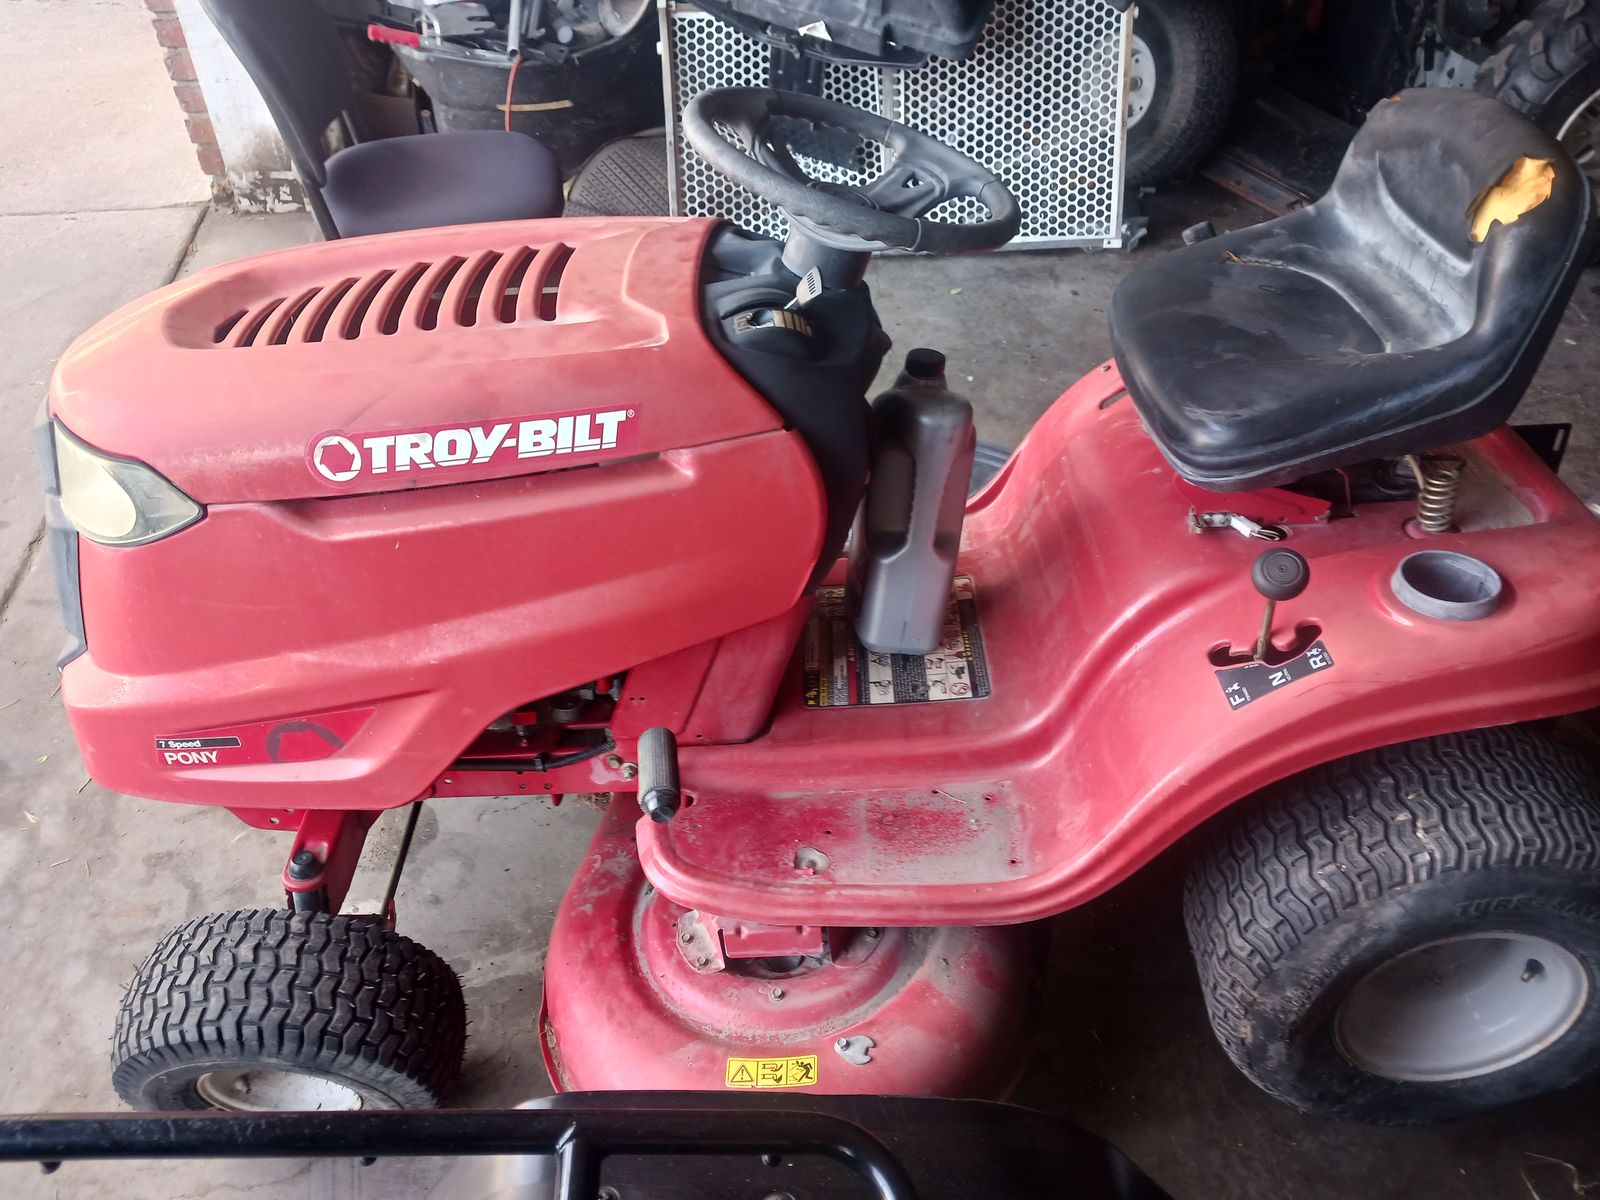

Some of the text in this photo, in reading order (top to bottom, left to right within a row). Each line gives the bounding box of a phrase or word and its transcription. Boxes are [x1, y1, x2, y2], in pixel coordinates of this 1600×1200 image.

[1309, 654, 1327, 669] R
[1268, 671, 1286, 687] N
[1229, 694, 1245, 706] F
[168, 740, 202, 749] Speed
[164, 751, 218, 765] PONY
